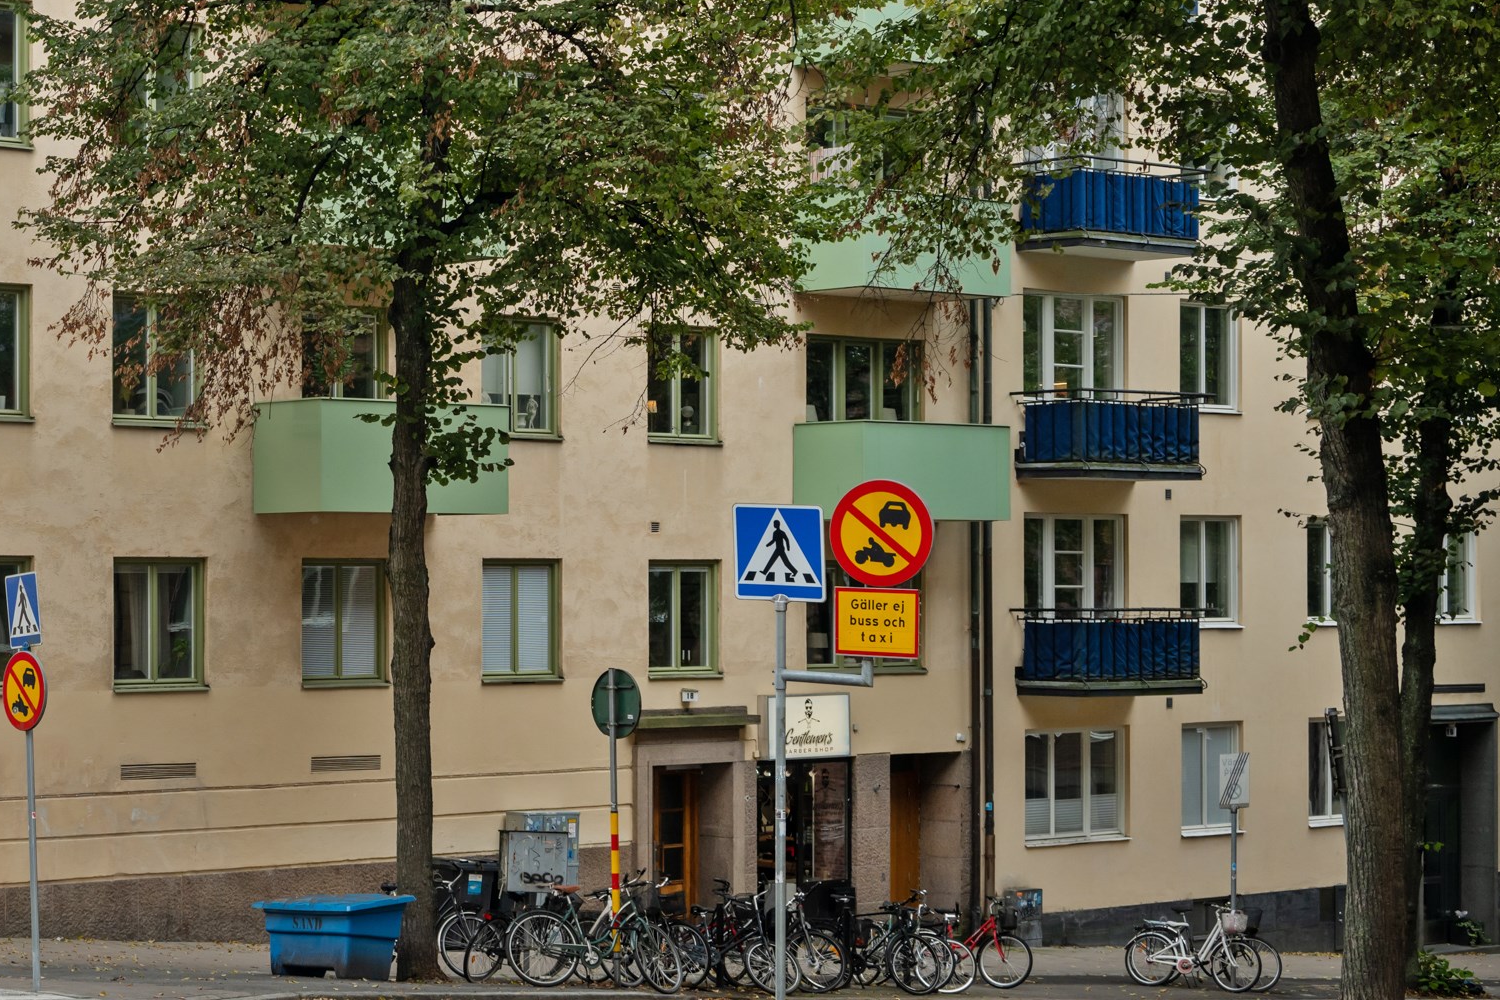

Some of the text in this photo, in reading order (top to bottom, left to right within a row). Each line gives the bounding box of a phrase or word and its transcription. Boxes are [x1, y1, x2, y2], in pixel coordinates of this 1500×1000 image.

[850, 598, 905, 614] Gäller ej
[850, 614, 906, 628] buss och
[861, 631, 893, 644] taxi
[785, 728, 833, 747] Gentlemen's
[292, 915, 323, 931] SAND
